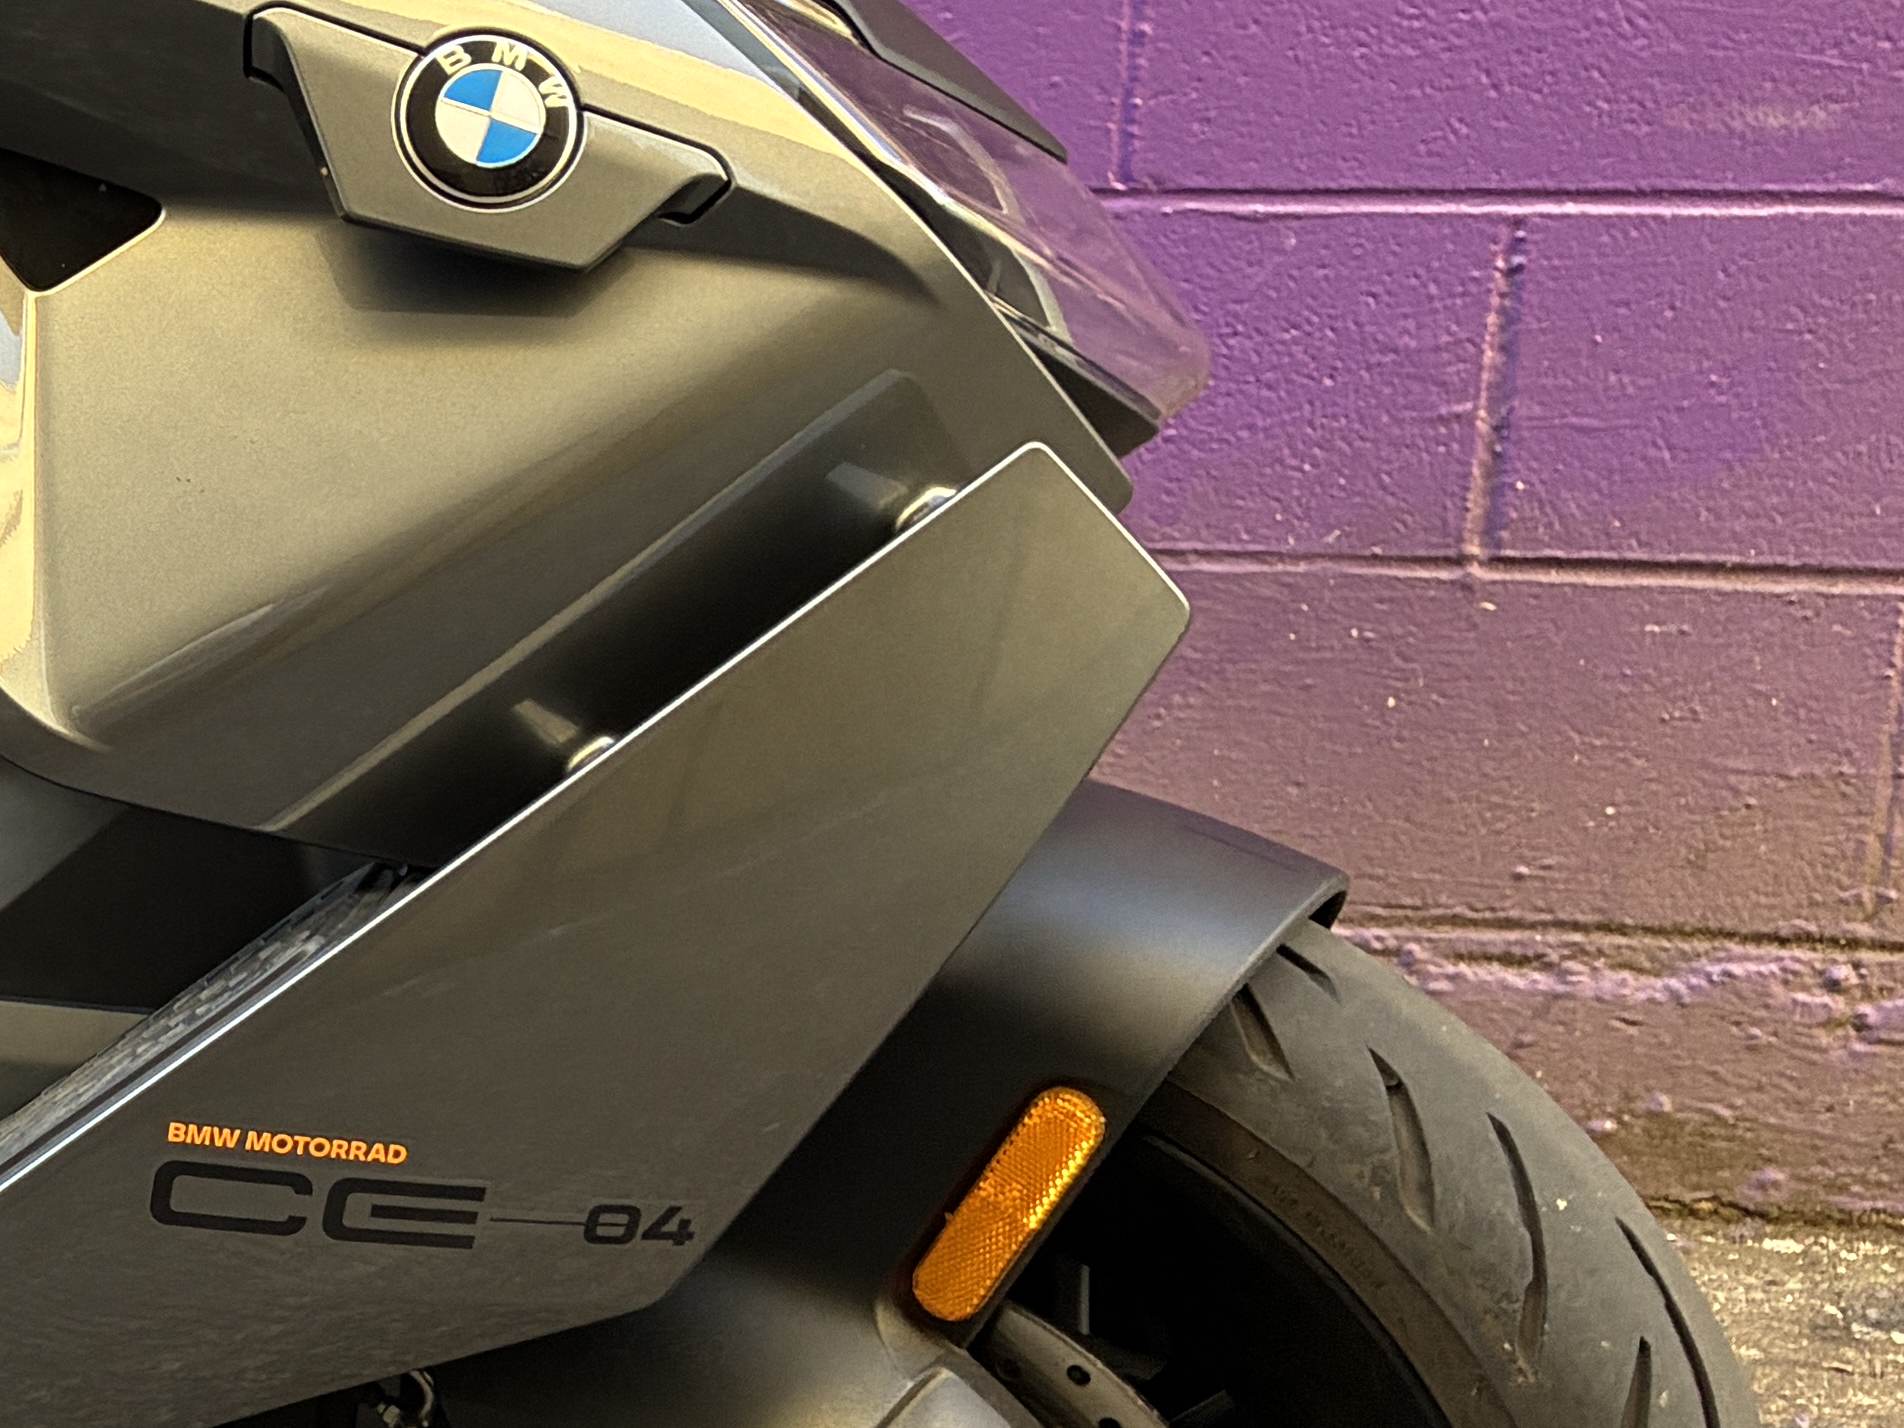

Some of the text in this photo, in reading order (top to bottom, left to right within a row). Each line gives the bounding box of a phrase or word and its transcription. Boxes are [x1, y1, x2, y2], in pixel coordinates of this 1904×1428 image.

[435, 40, 570, 108] BMW
[167, 1121, 409, 1165] BMW MOTORRAD
[149, 1158, 488, 1251] CE
